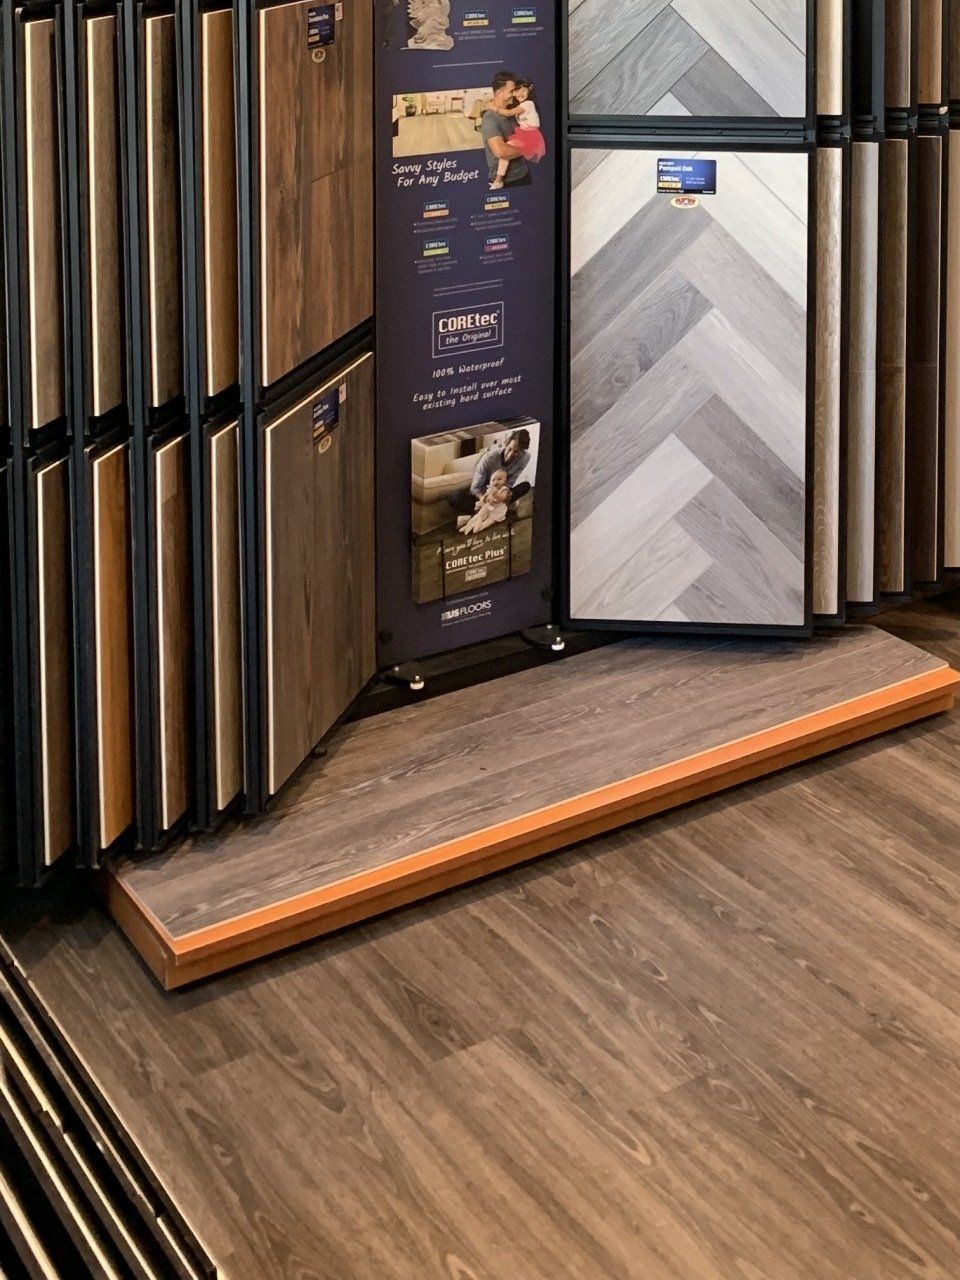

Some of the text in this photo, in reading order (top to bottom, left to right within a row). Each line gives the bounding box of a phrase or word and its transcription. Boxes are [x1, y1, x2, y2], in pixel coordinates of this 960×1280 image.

[391, 158, 457, 175] Savvy Styles
[397, 169, 479, 187] For Any Budget
[438, 312, 498, 333] COREtec
[462, 330, 491, 344] Original
[432, 357, 504, 378] 100% Waterproof
[413, 375, 522, 402] Easy to Install over most
[422, 387, 513, 410] existing hard surface
[485, 549, 504, 559] Plus
